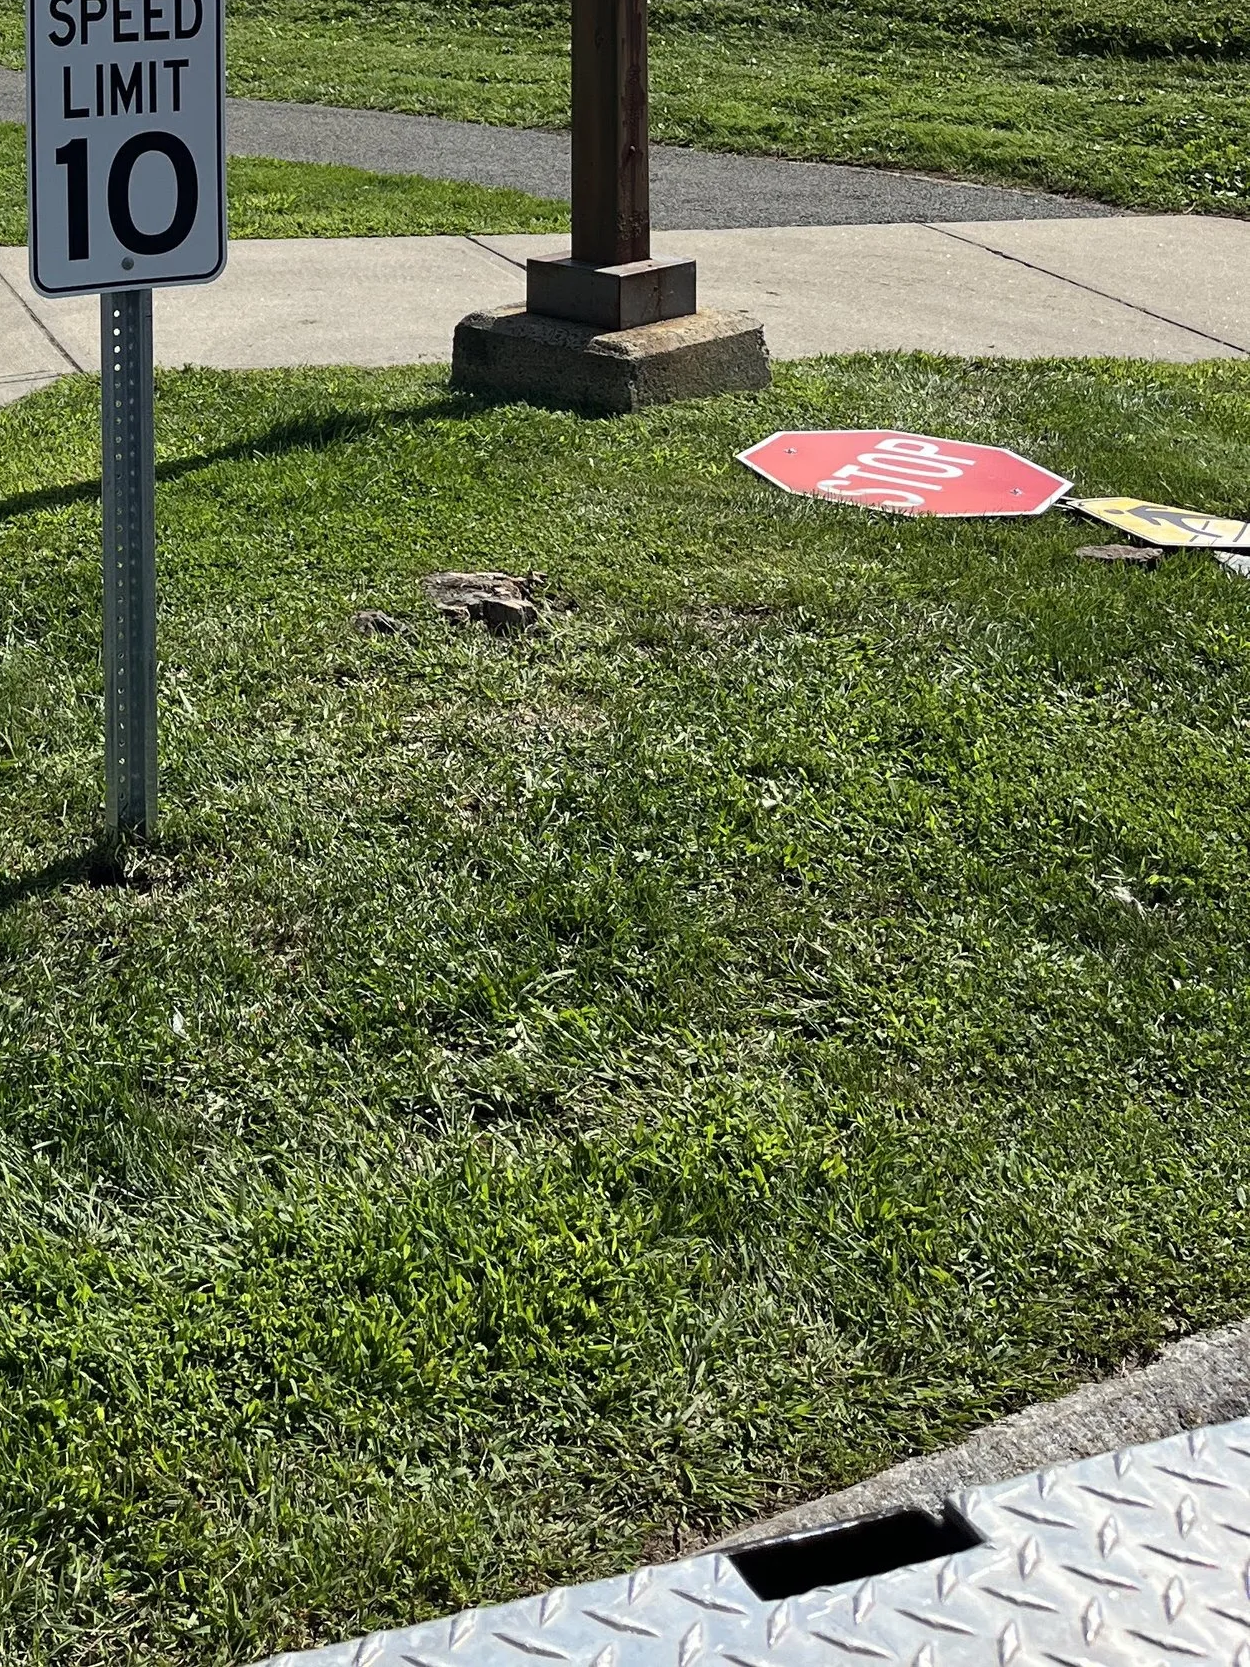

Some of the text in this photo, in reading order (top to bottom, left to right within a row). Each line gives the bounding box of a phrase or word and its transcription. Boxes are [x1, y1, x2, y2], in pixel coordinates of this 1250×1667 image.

[63, 59, 190, 119] LIMIT
[55, 130, 199, 261] 10
[817, 438, 977, 507] STOP
